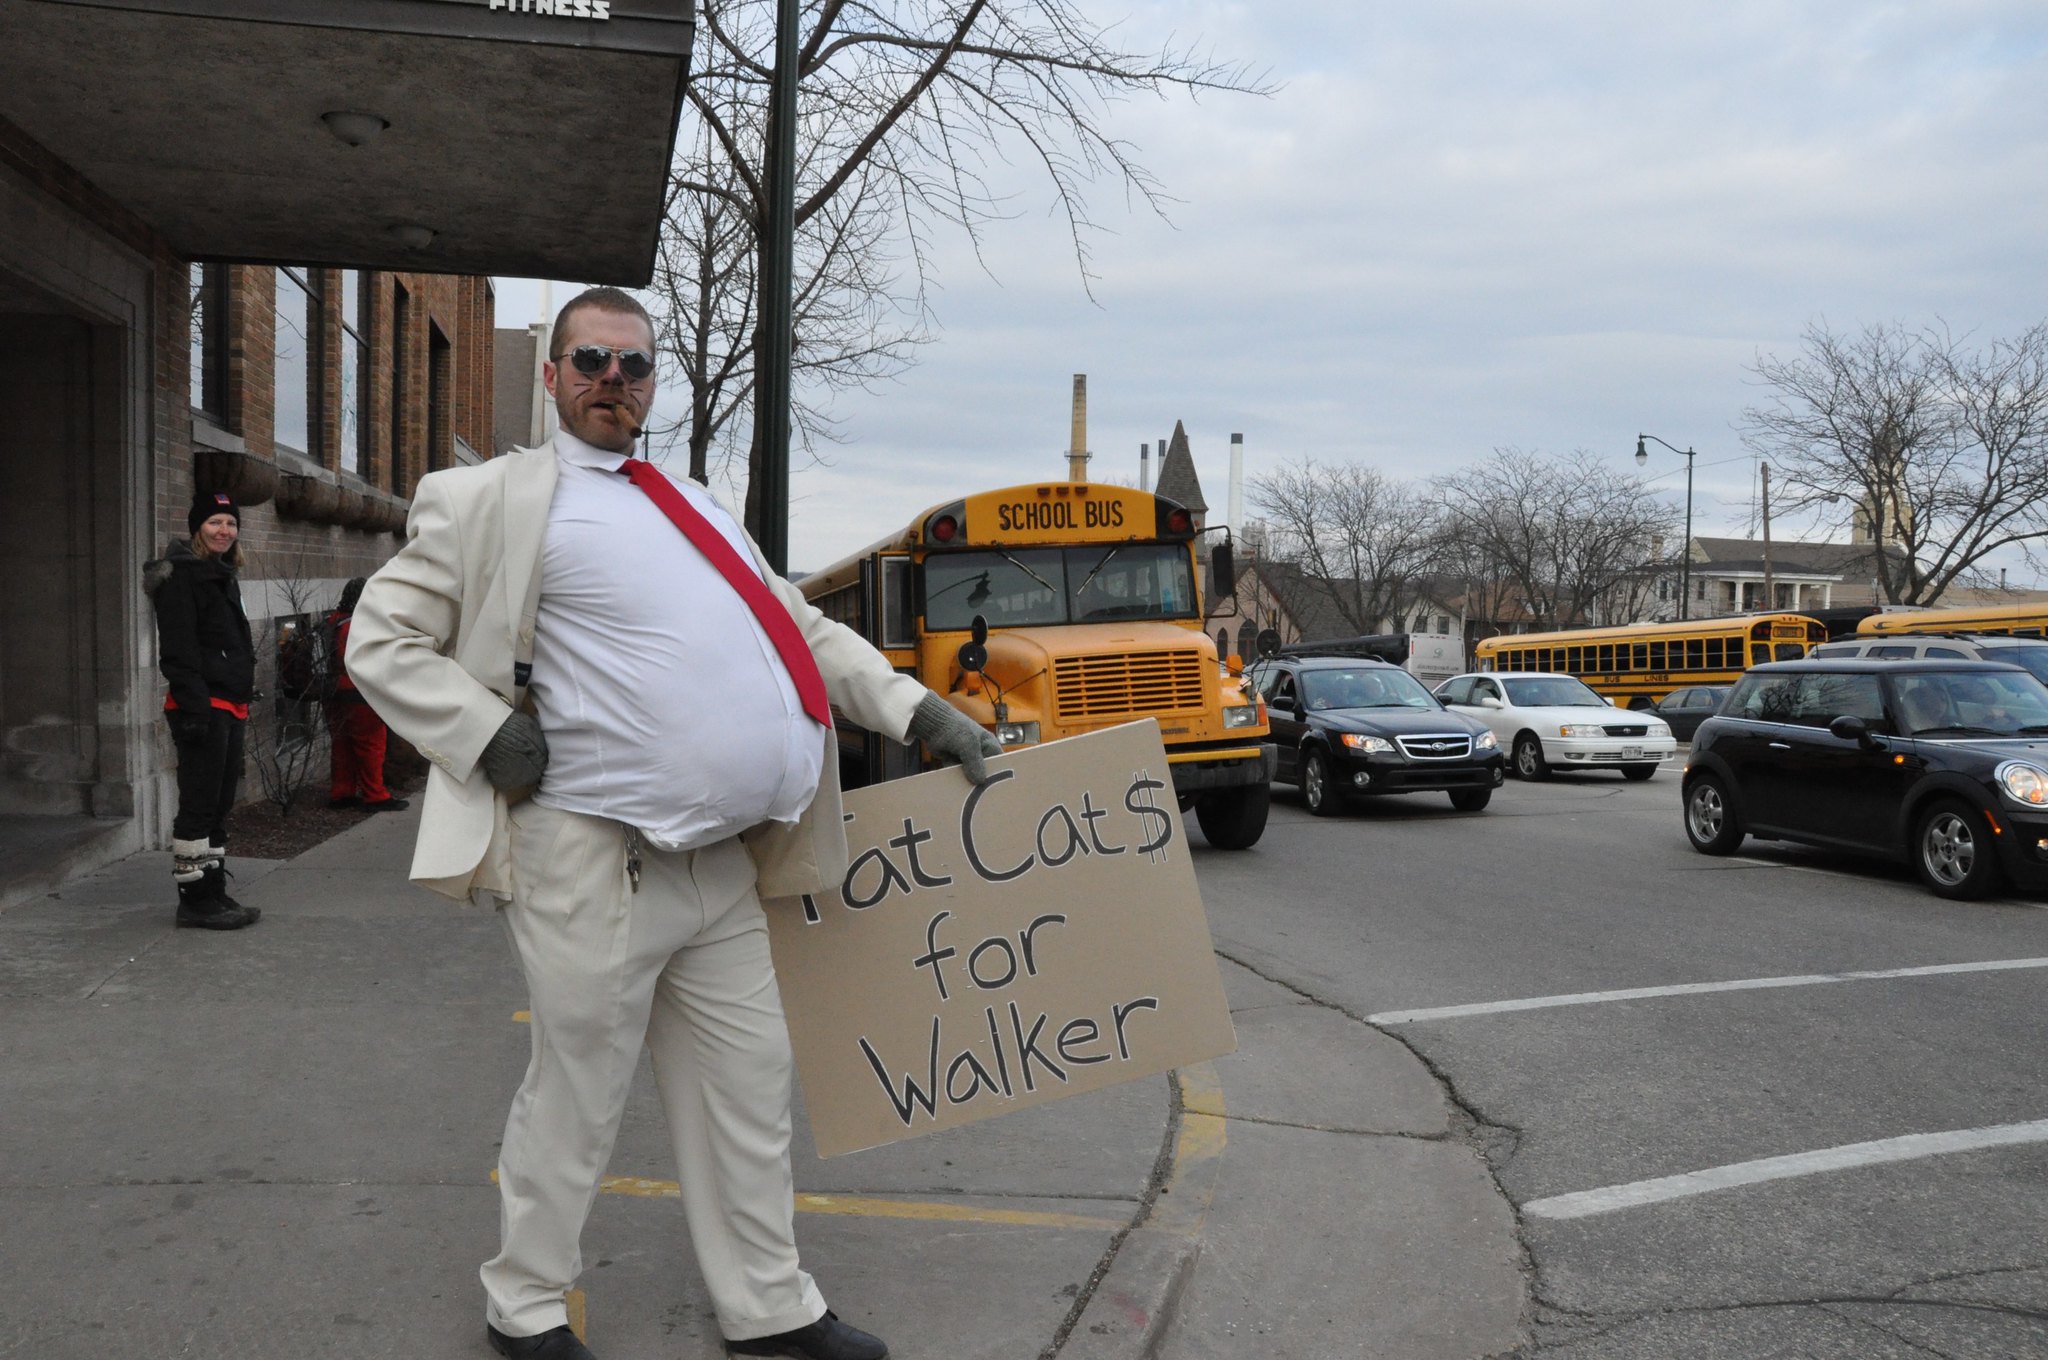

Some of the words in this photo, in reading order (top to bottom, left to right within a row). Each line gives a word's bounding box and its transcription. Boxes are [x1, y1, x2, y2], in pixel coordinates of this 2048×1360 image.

[998, 501, 1078, 531] SCHOOL
[1085, 500, 1124, 528] BUS
[1604, 675, 1620, 683] BUS
[1644, 674, 1669, 682] LINES
[801, 813, 953, 925] at
[961, 769, 1173, 883] Cat$
[913, 910, 1067, 1002] for
[857, 996, 1159, 1127] Walker
